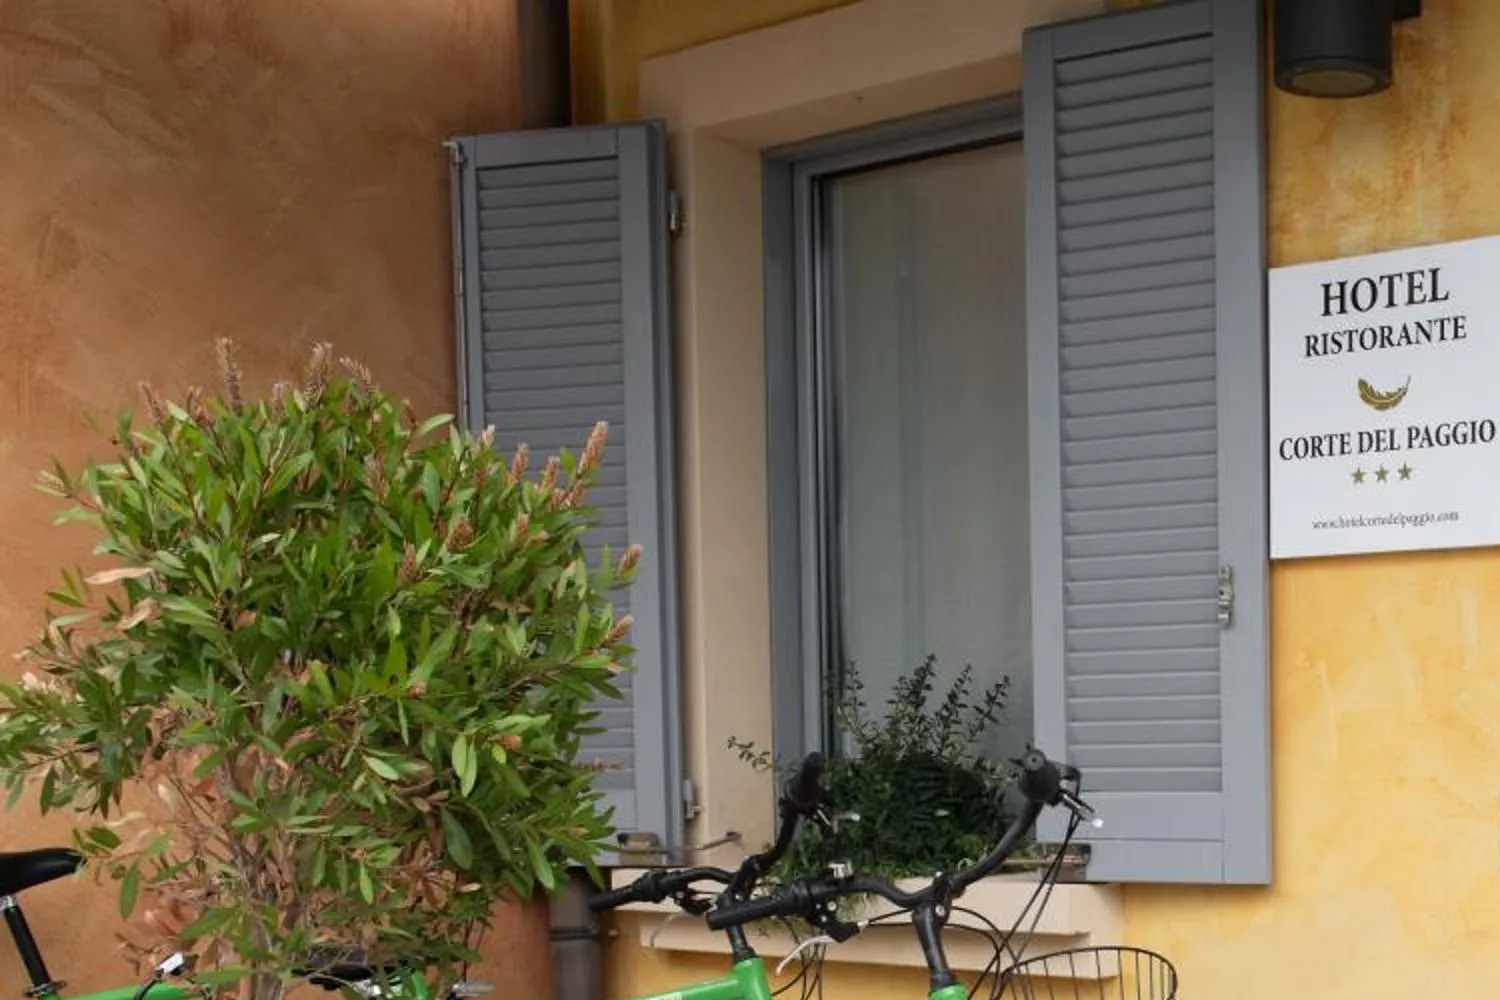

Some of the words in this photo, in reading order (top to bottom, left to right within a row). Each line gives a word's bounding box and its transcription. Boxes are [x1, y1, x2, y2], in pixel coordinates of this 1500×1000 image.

[1320, 267, 1449, 317] HOTEL
[1304, 315, 1467, 358] RISTORANTE
[1279, 432, 1351, 461] CORTE
[1358, 428, 1400, 454] DEL
[1407, 418, 1497, 450] PAGGIO
